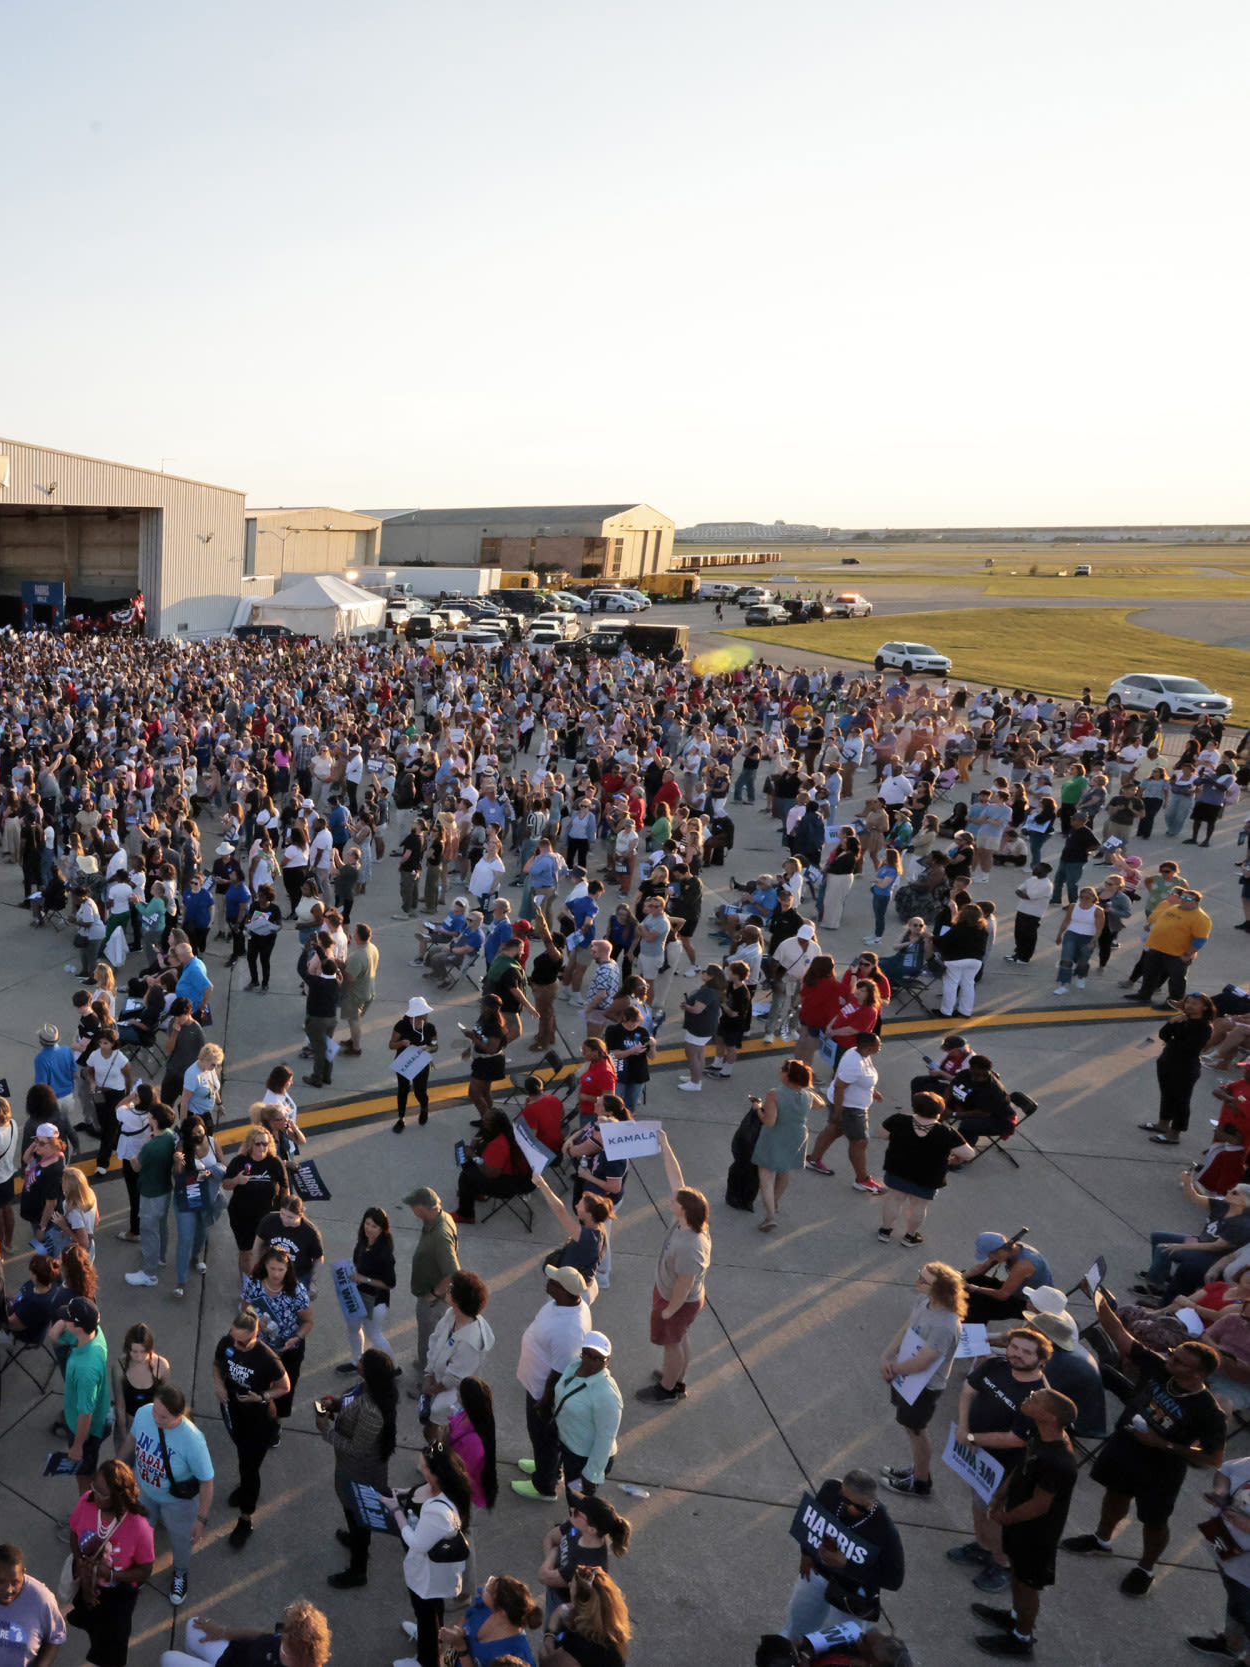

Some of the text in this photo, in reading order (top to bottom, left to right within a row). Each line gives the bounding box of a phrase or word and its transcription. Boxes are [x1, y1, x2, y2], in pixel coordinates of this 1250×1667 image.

[608, 1131, 657, 1145] KAMALA
[298, 1166, 323, 1198] HARRIS
[335, 1267, 357, 1314] WE WIN
[230, 1366, 249, 1378] STUPID
[137, 1432, 153, 1452] IN
[952, 1440, 1000, 1487] WE WIN
[140, 1468, 162, 1488] RA
[367, 1510, 387, 1529] WE
[801, 1505, 868, 1566] HARRIS
